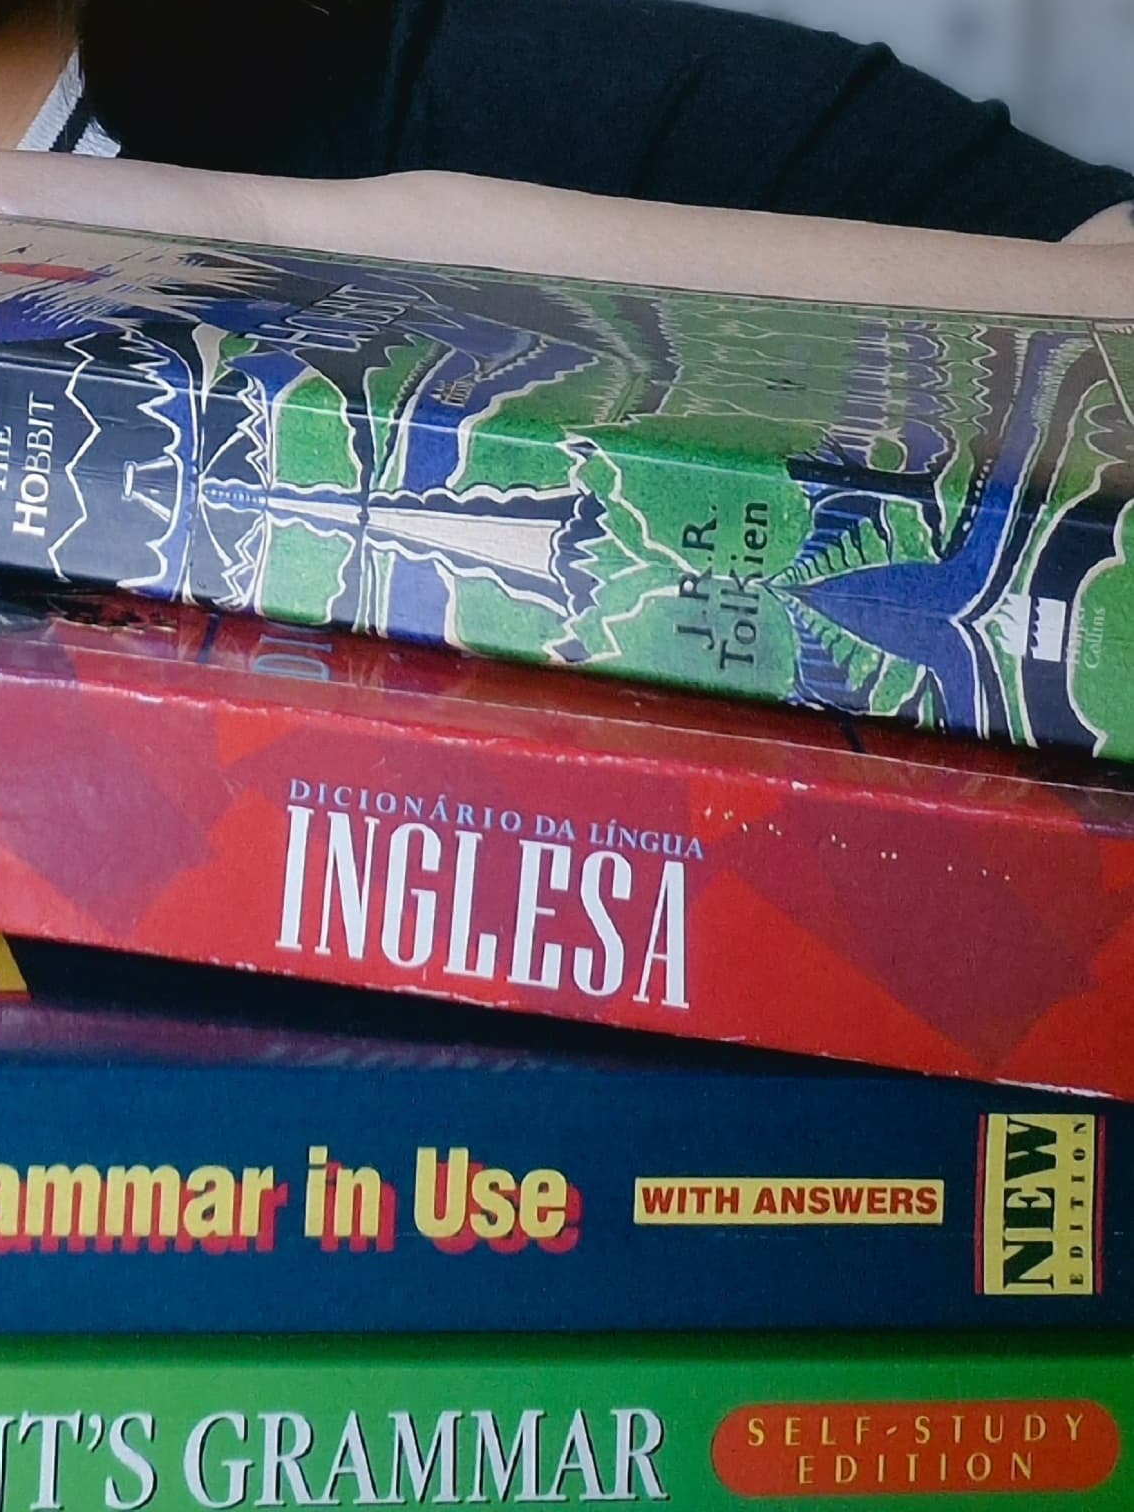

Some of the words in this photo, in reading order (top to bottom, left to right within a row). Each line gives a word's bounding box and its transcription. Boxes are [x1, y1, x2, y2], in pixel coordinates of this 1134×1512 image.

[12, 391, 55, 537] HOBBIT
[720, 502, 768, 671] Tolkien
[289, 778, 523, 834] DICIONÁRIO
[535, 814, 576, 842] DA
[590, 818, 705, 860] LÍNGUA
[274, 805, 691, 1010] INGLESA
[304, 1145, 385, 1241] in
[414, 1146, 571, 1242] Use
[641, 1187, 740, 1216] WITH
[753, 1187, 938, 1216] ANSWERS
[1003, 1117, 1058, 1291] NEW
[1069, 1119, 1088, 1287] EDITION
[183, 1407, 669, 1509] GRAMMAR
[747, 1413, 1084, 1446] SELF-STUDY
[798, 1451, 1034, 1485] EDITION
